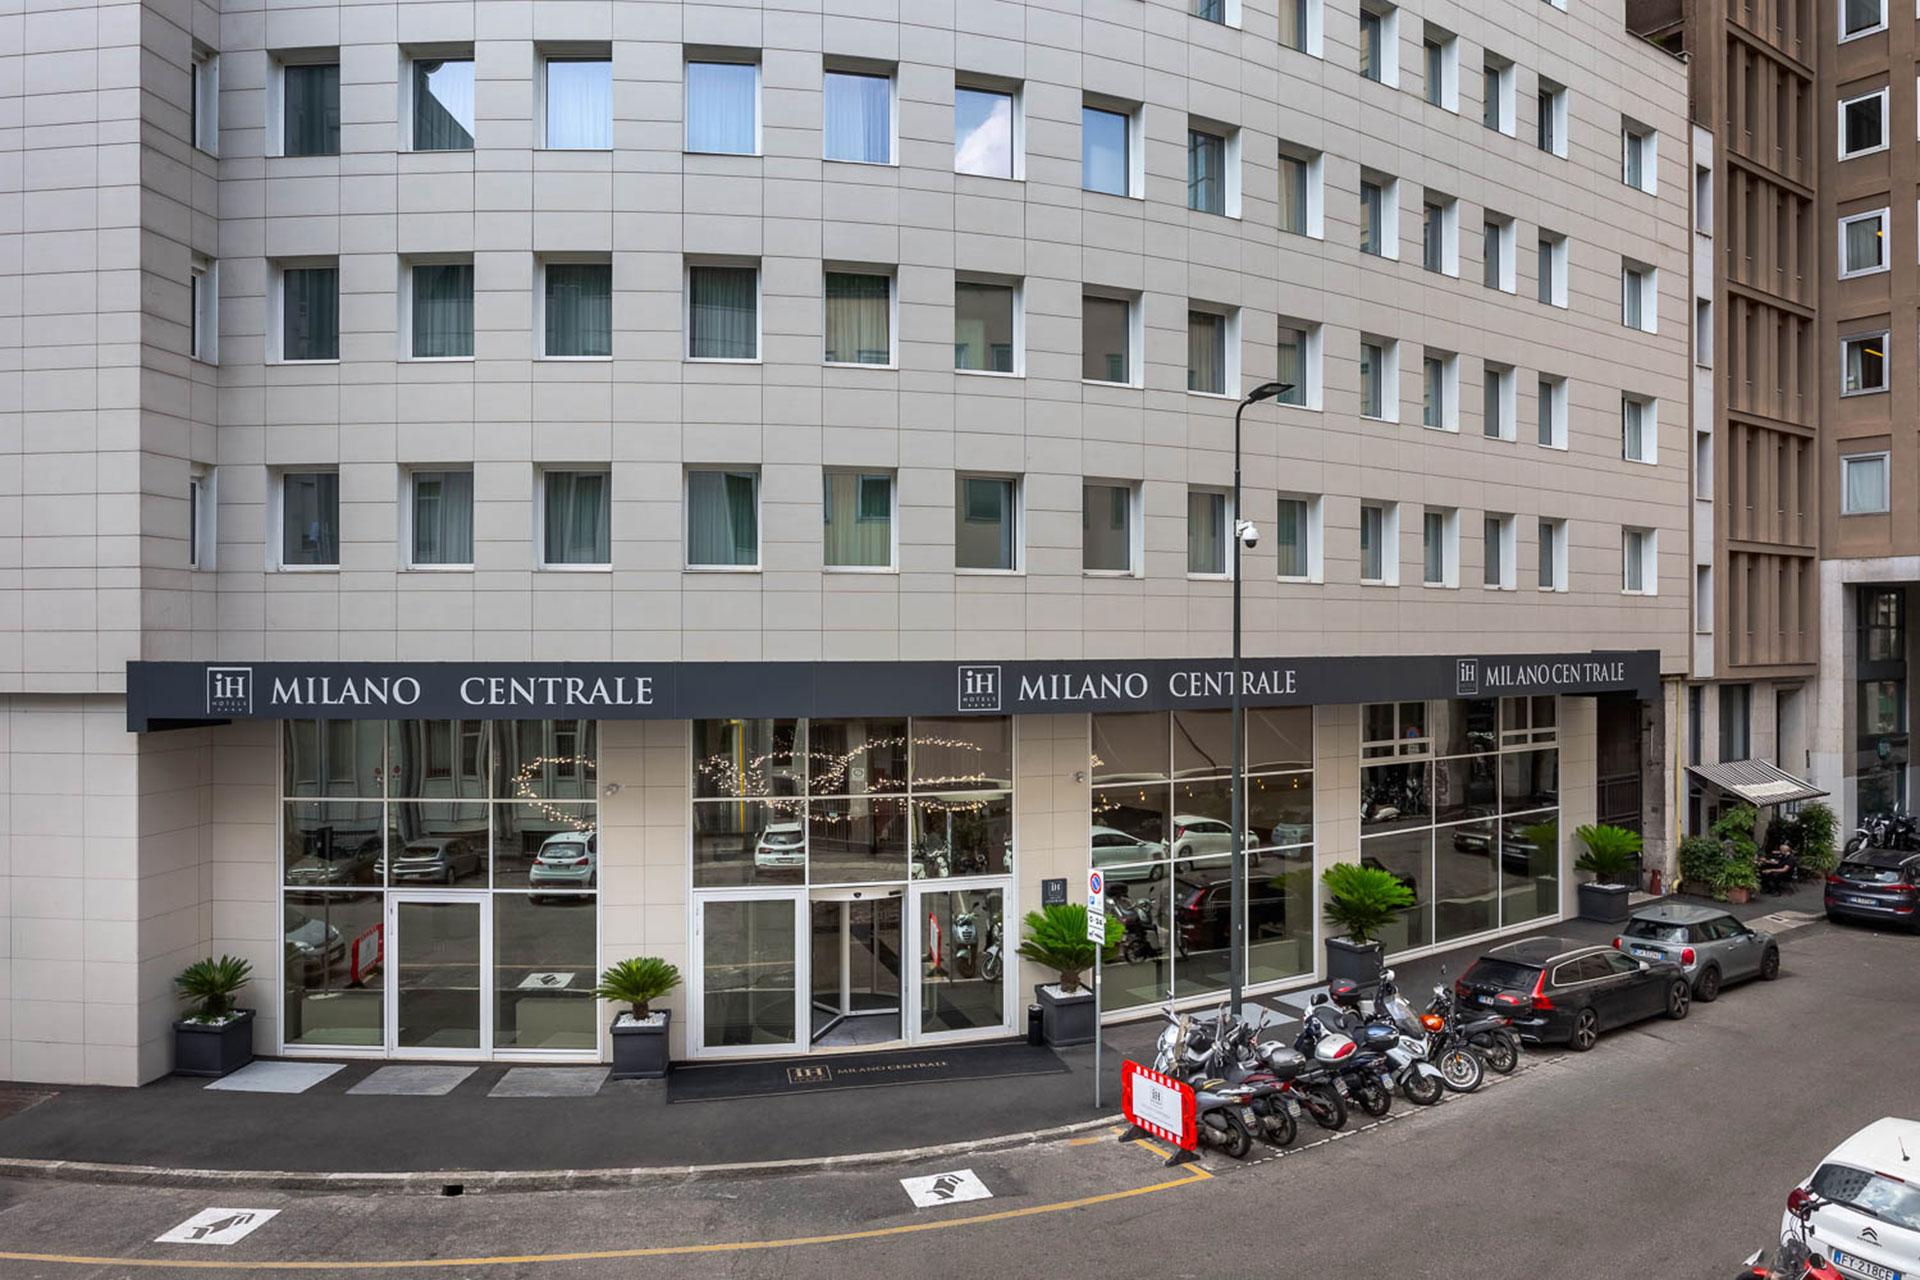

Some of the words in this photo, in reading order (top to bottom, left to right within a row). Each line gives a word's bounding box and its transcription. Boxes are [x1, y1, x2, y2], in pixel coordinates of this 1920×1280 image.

[965, 670, 994, 694] iH
[1460, 662, 1475, 682] iH
[1485, 663, 1550, 687] MILANO
[1551, 662, 1625, 684] CENTRALE
[214, 673, 245, 698] iH
[271, 676, 421, 705] MILANO
[460, 676, 654, 705] CENTRALE
[1018, 672, 1149, 701] MILANO
[1169, 670, 1297, 698] CENTRALE
